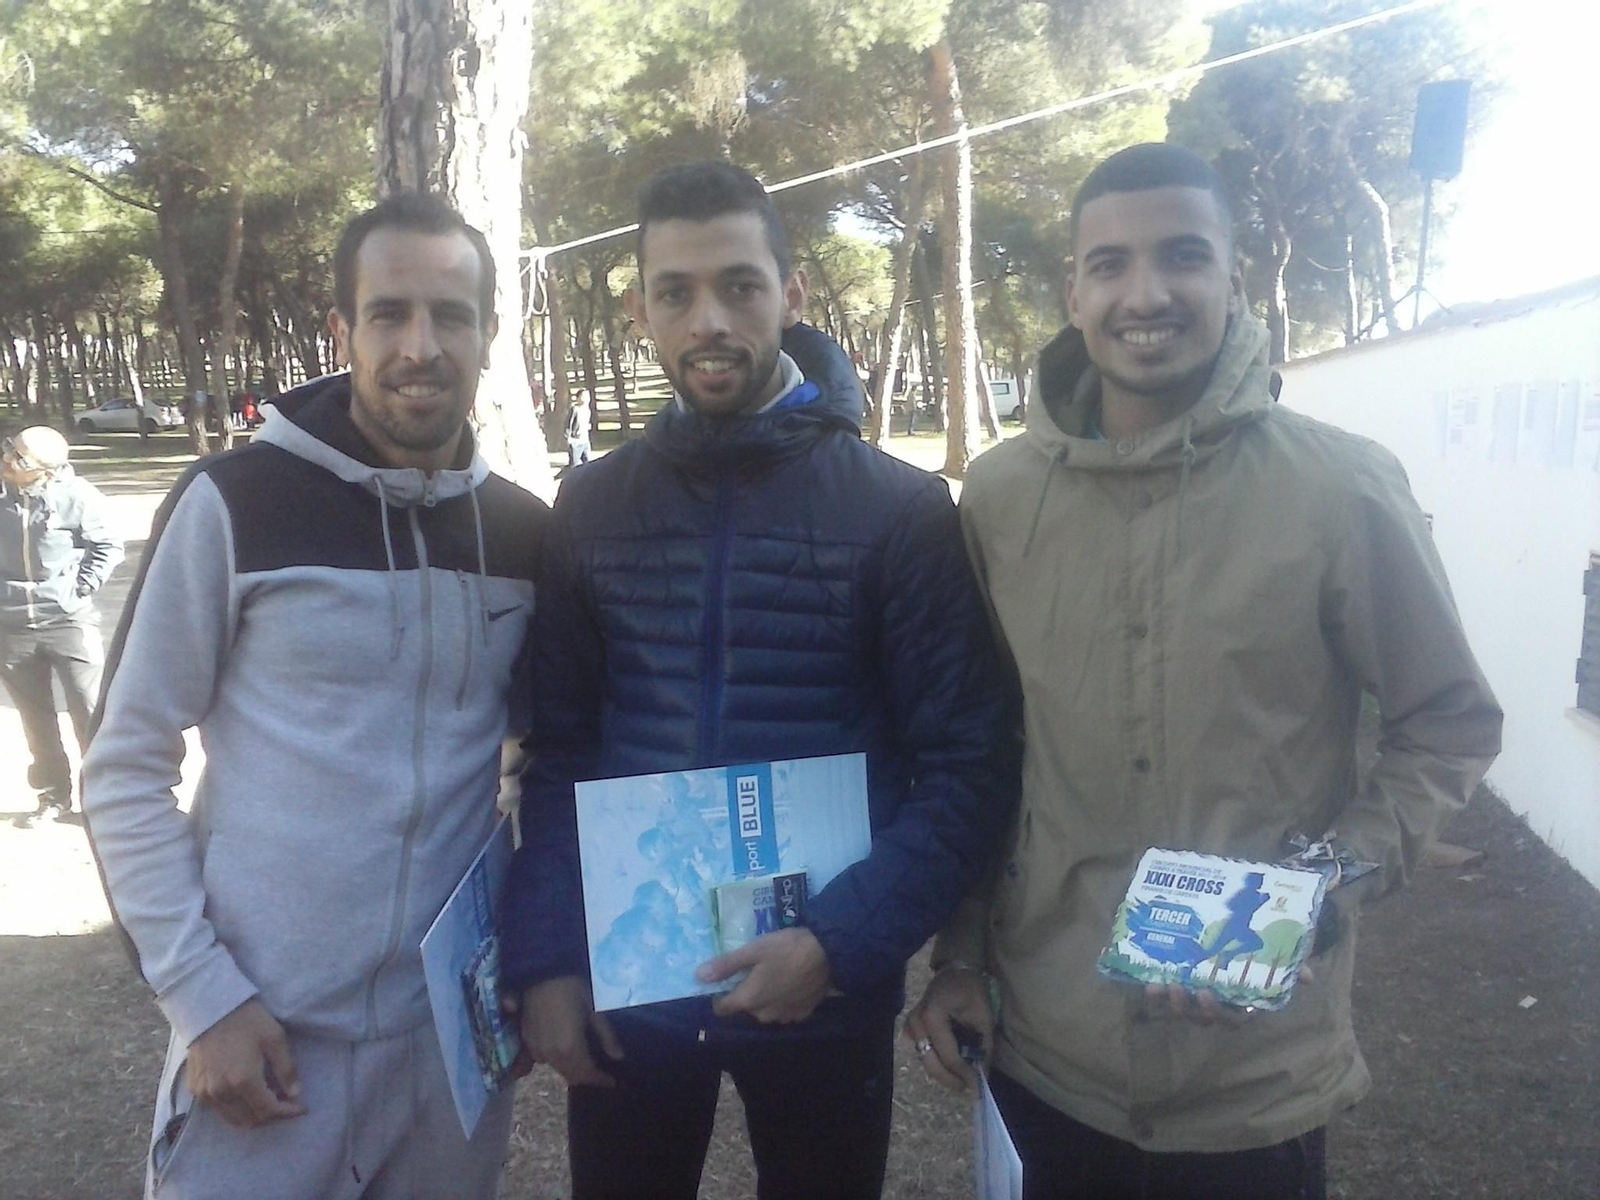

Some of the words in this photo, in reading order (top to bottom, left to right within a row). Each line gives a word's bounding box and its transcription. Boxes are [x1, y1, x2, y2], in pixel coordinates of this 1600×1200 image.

[740, 781, 758, 831] BLUE
[1143, 870, 1176, 888] XXXI
[1176, 876, 1225, 895] CROSS
[1149, 907, 1192, 926] TERCER
